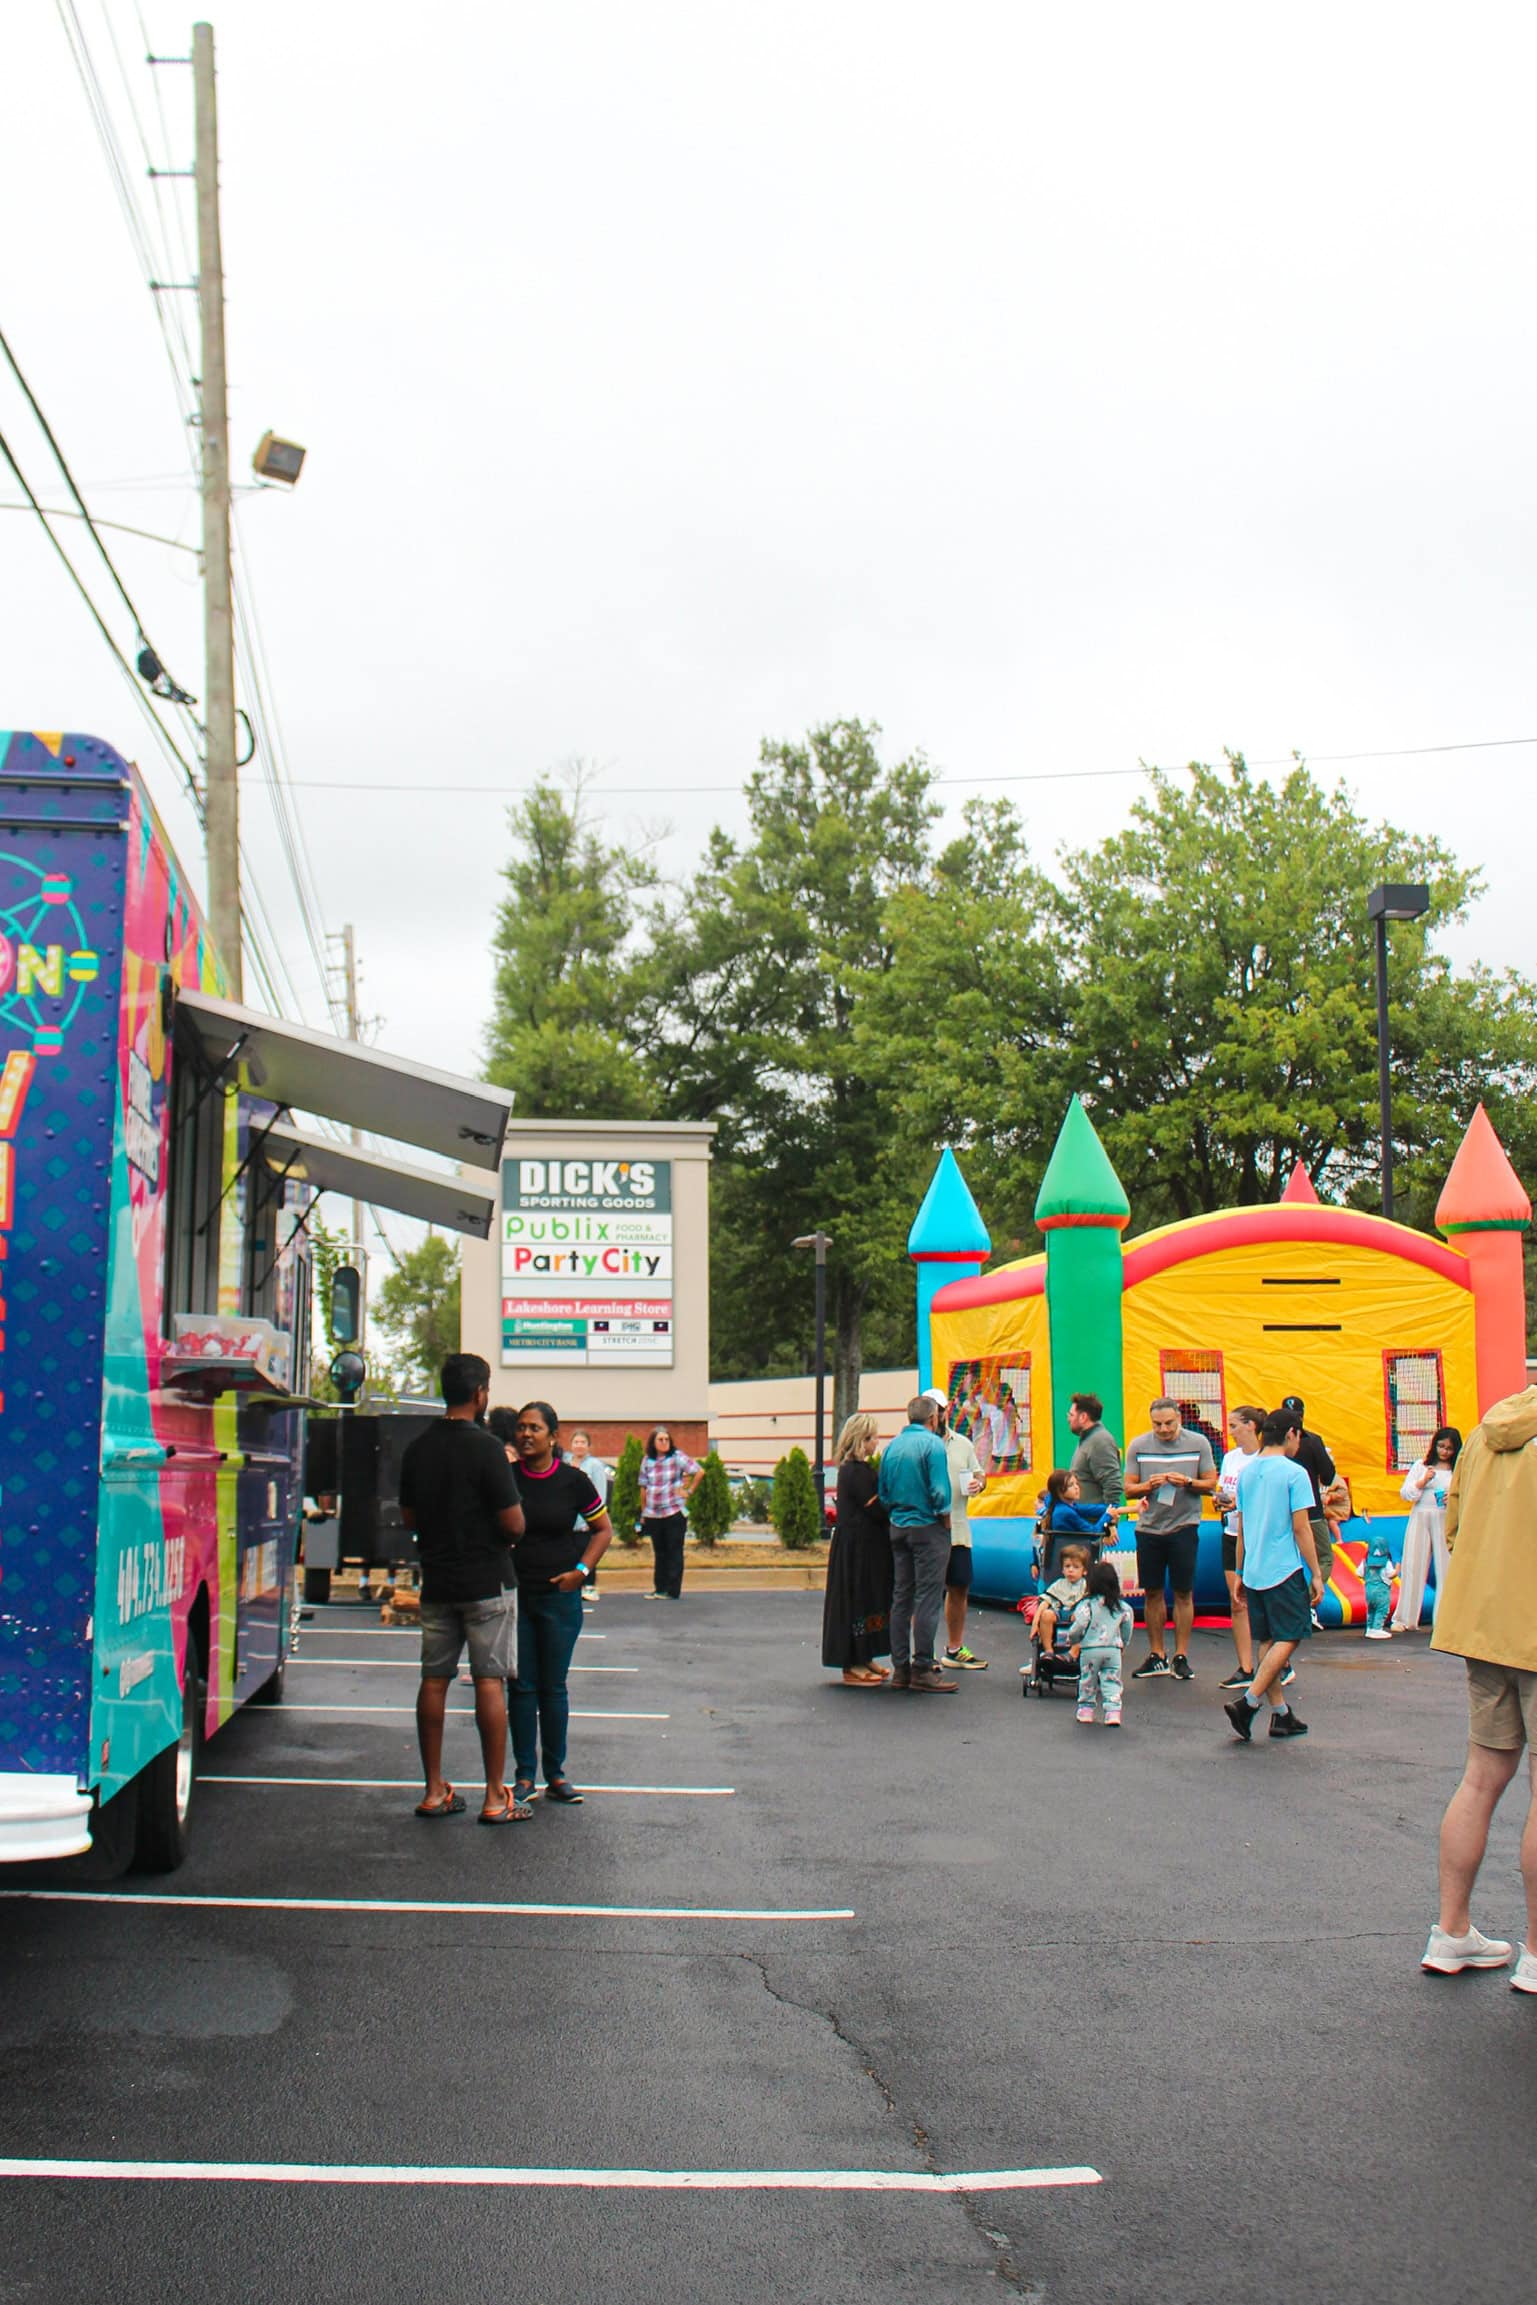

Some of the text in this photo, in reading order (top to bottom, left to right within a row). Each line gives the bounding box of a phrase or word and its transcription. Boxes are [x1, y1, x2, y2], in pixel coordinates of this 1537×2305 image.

[519, 1160, 656, 1195] DICK'S
[519, 1196, 656, 1209] SPORTING GOODS
[506, 1216, 610, 1241] Publix
[506, 1301, 669, 1317] Lakeshore Learning Store
[602, 1336, 637, 1344] STRETCH
